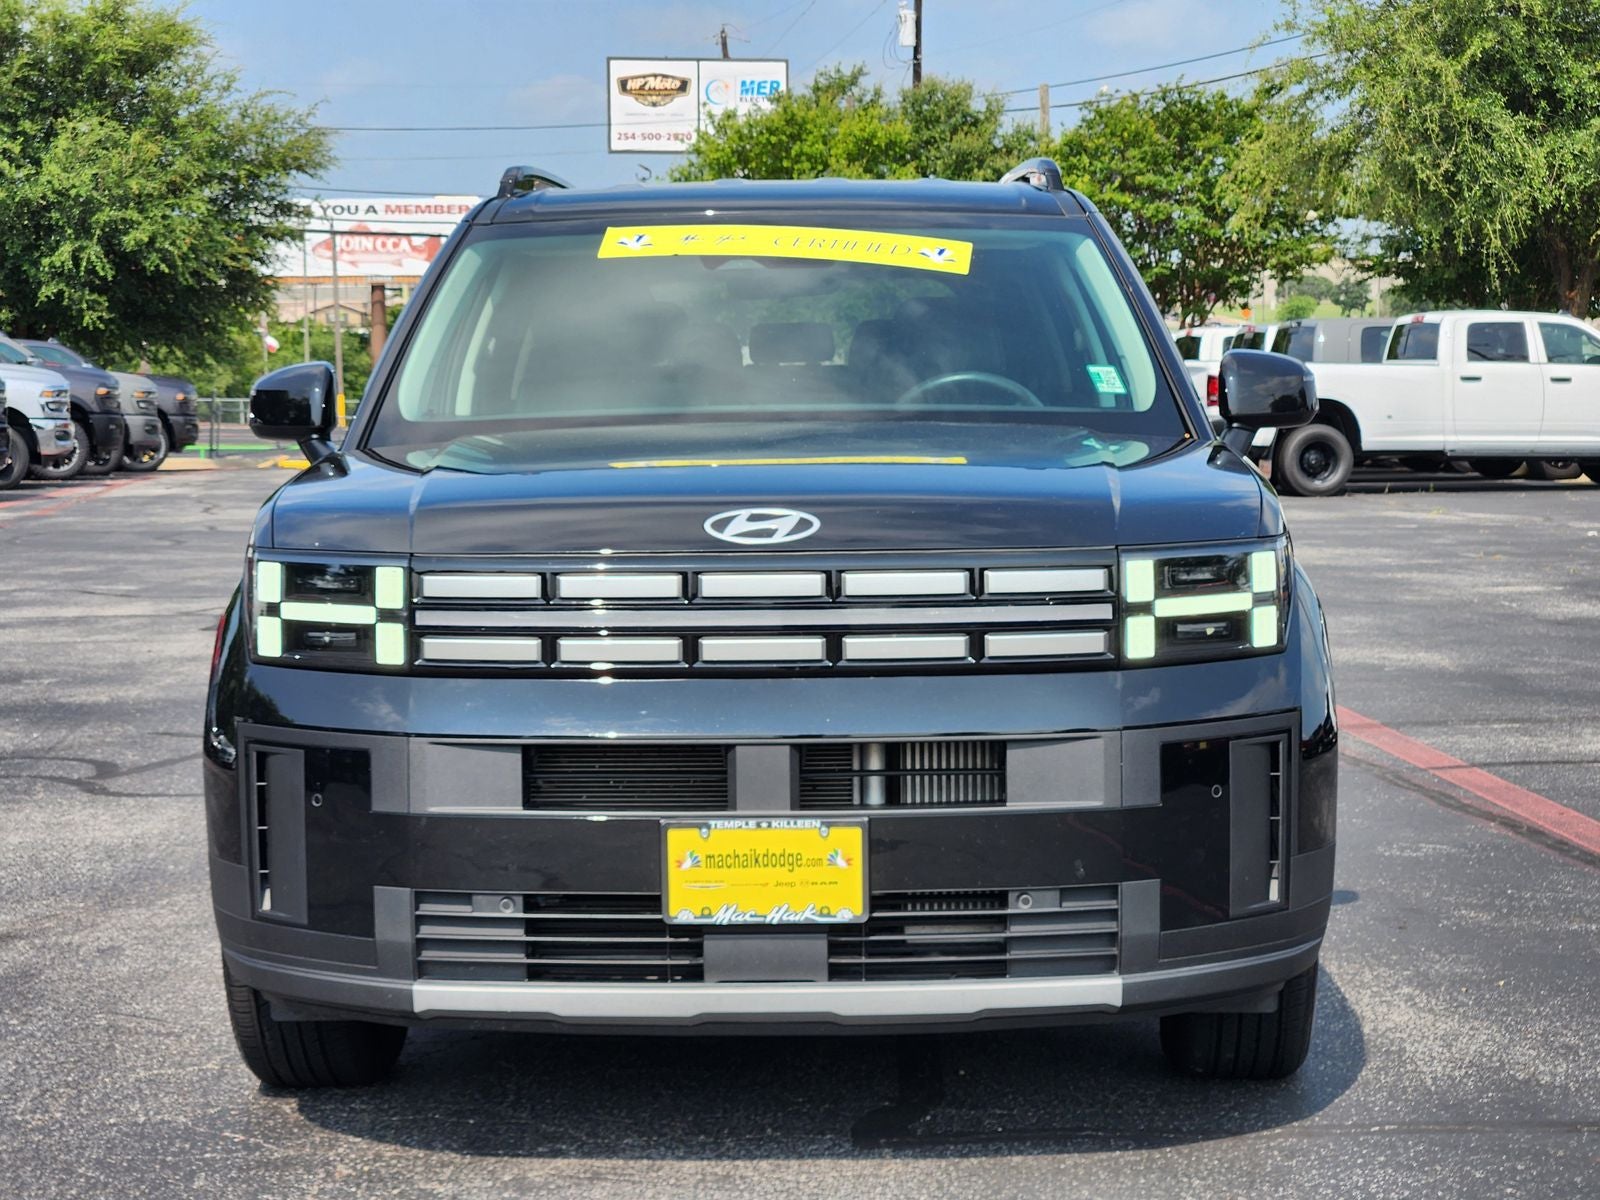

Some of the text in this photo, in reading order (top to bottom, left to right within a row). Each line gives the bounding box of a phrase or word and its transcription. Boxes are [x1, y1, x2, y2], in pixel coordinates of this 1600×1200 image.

[319, 204, 359, 216] YOU
[364, 204, 378, 215] A
[375, 236, 412, 253] CCA
[708, 819, 821, 830] TEMPLE KILLEEN
[705, 849, 824, 872] machaikdodge.com
